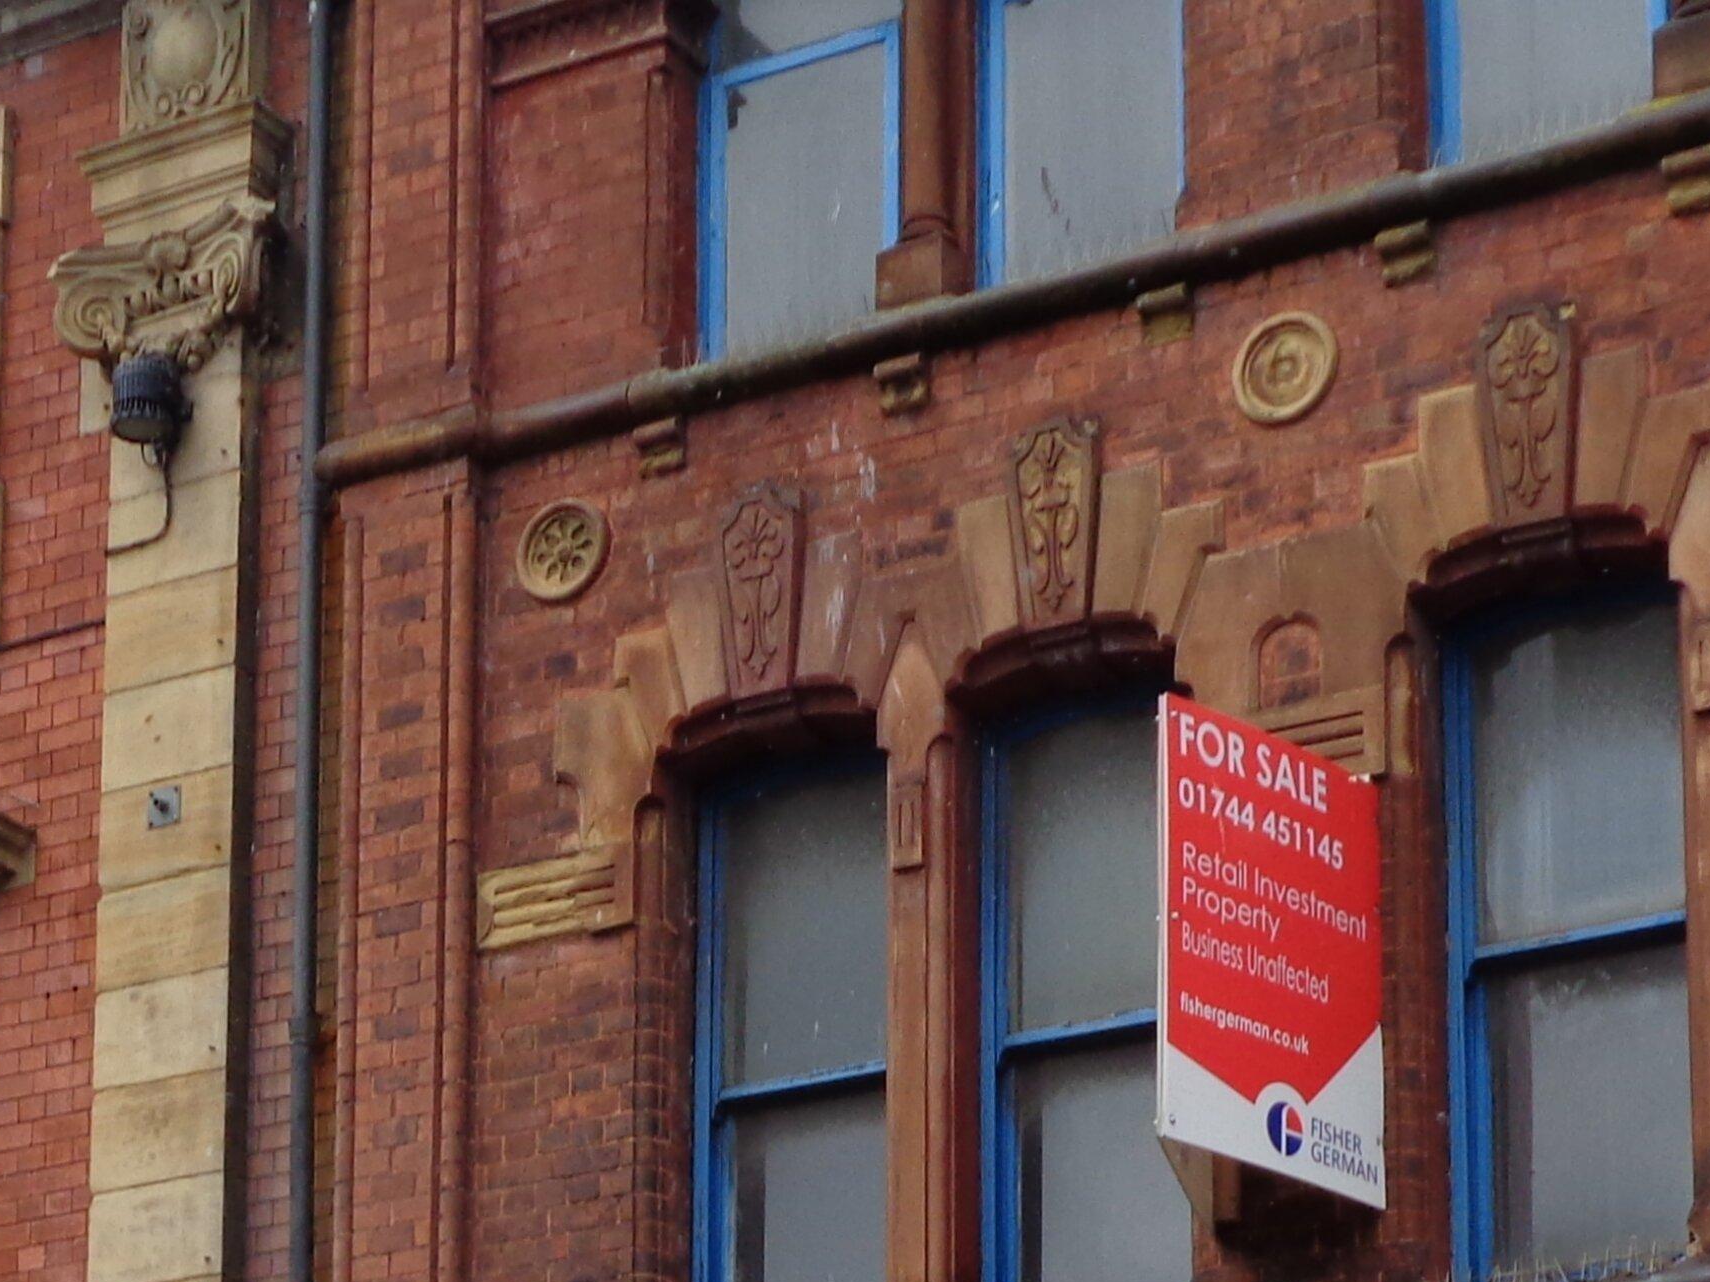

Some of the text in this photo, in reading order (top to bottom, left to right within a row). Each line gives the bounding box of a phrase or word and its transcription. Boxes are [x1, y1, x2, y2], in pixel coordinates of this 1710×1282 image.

[1179, 712, 1328, 814] FOR SALE
[1178, 776, 1344, 870] 01744 451145
[1182, 841, 1367, 942] Retail Investment
[1182, 876, 1281, 942] Property
[1181, 919, 1329, 1004] Business Unaffected
[1180, 990, 1310, 1056] fishergerman.co.uk
[1310, 1116, 1363, 1156] FISHER
[1310, 1141, 1379, 1186] GERMAN
